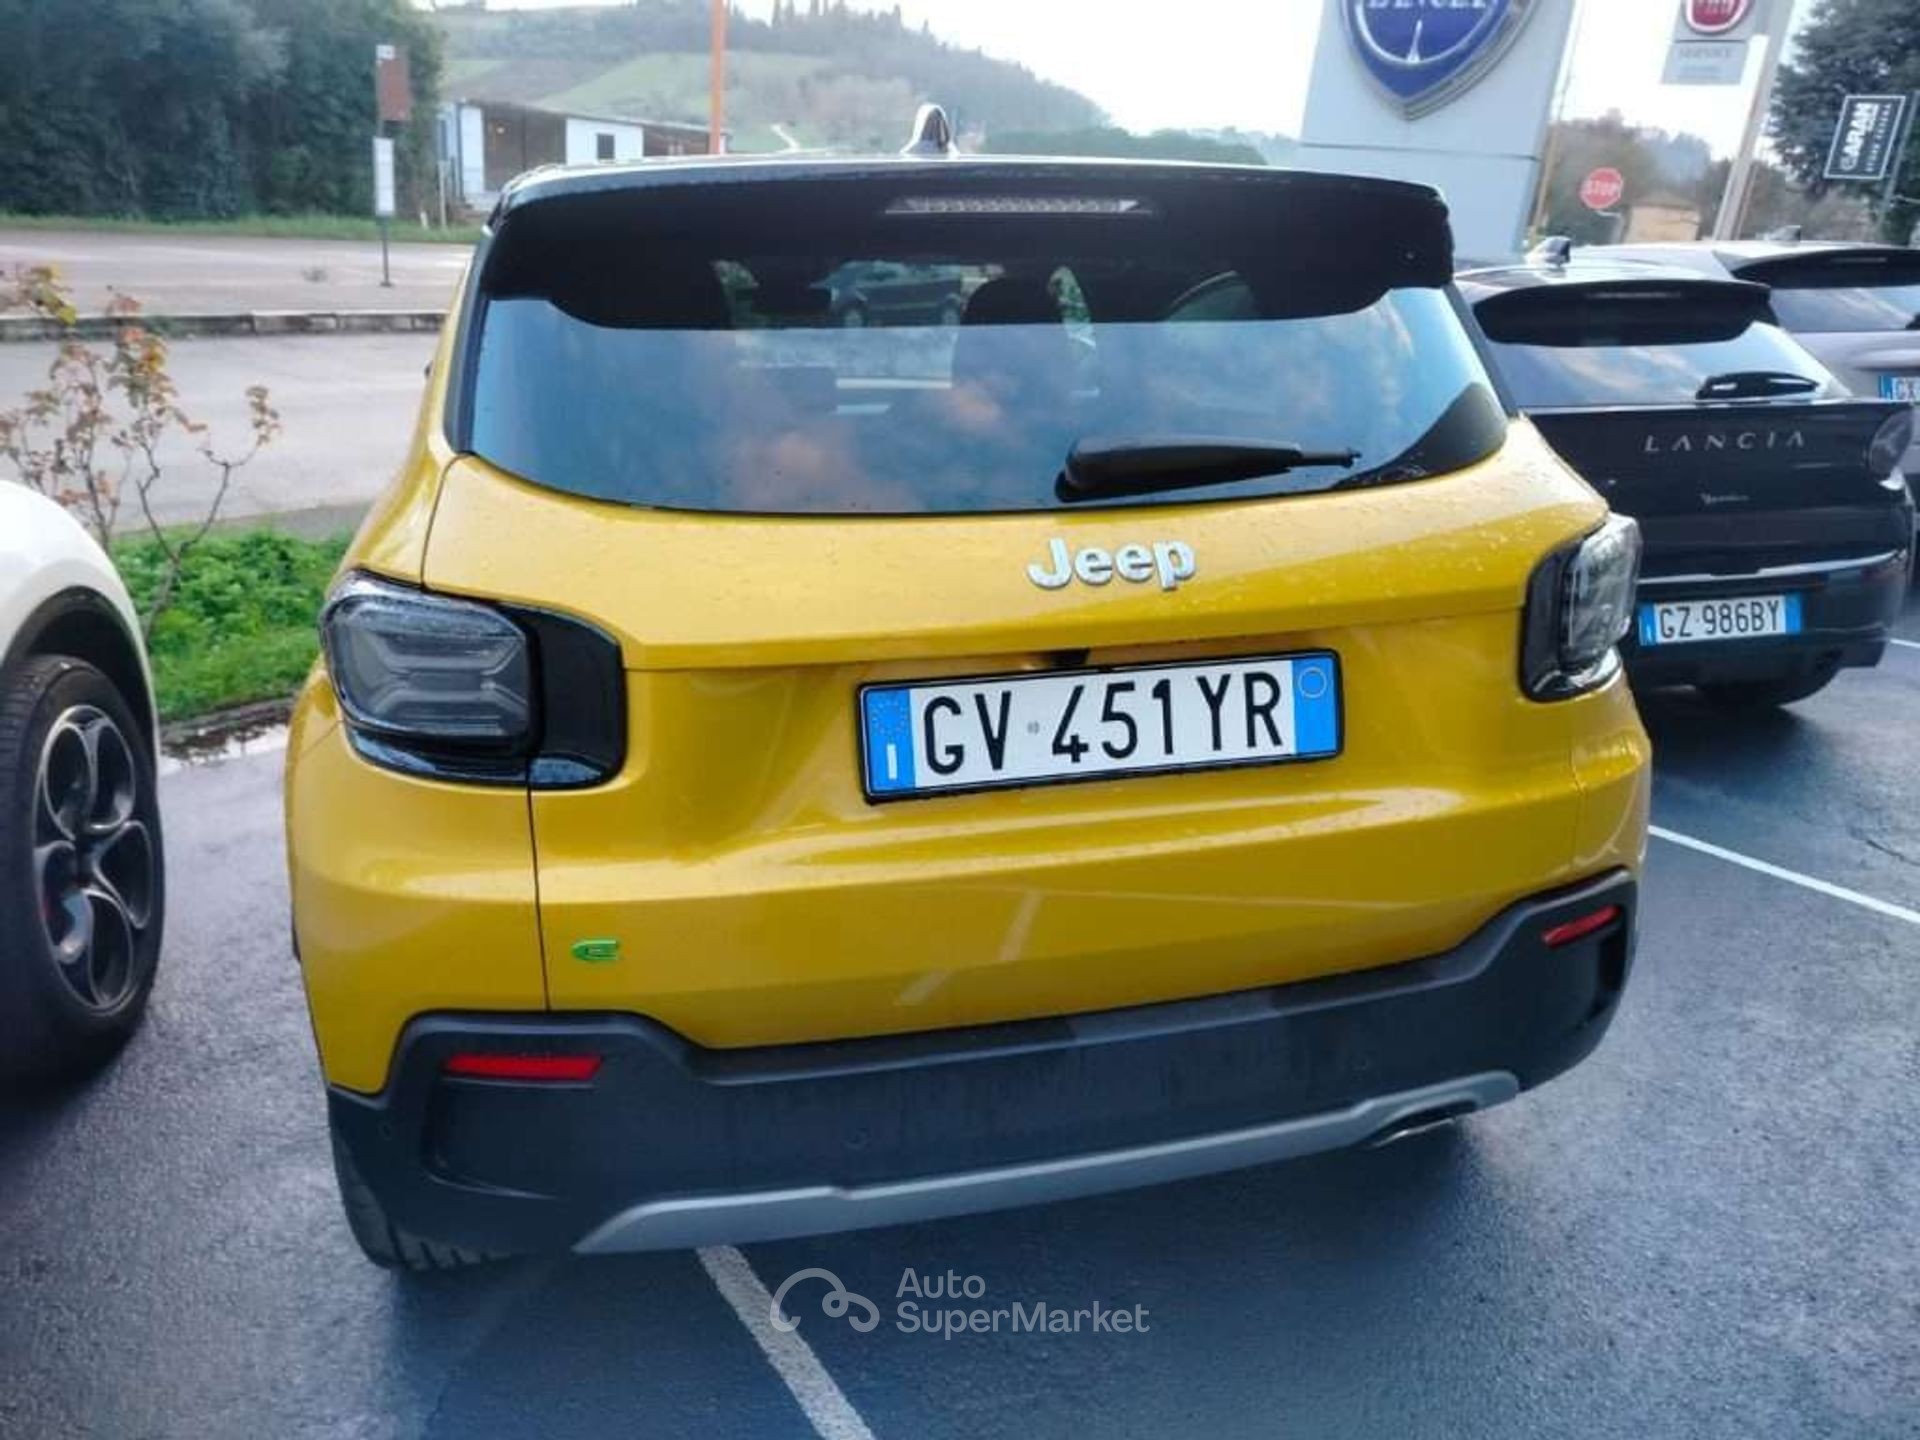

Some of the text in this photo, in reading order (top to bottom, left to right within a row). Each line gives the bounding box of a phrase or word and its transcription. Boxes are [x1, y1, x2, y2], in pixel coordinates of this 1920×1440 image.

[1644, 430, 1805, 452] LANCIA
[1026, 537, 1198, 590] Jeep
[1659, 599, 1780, 639] GZ 986BY
[922, 671, 1284, 776] GV 451YR
